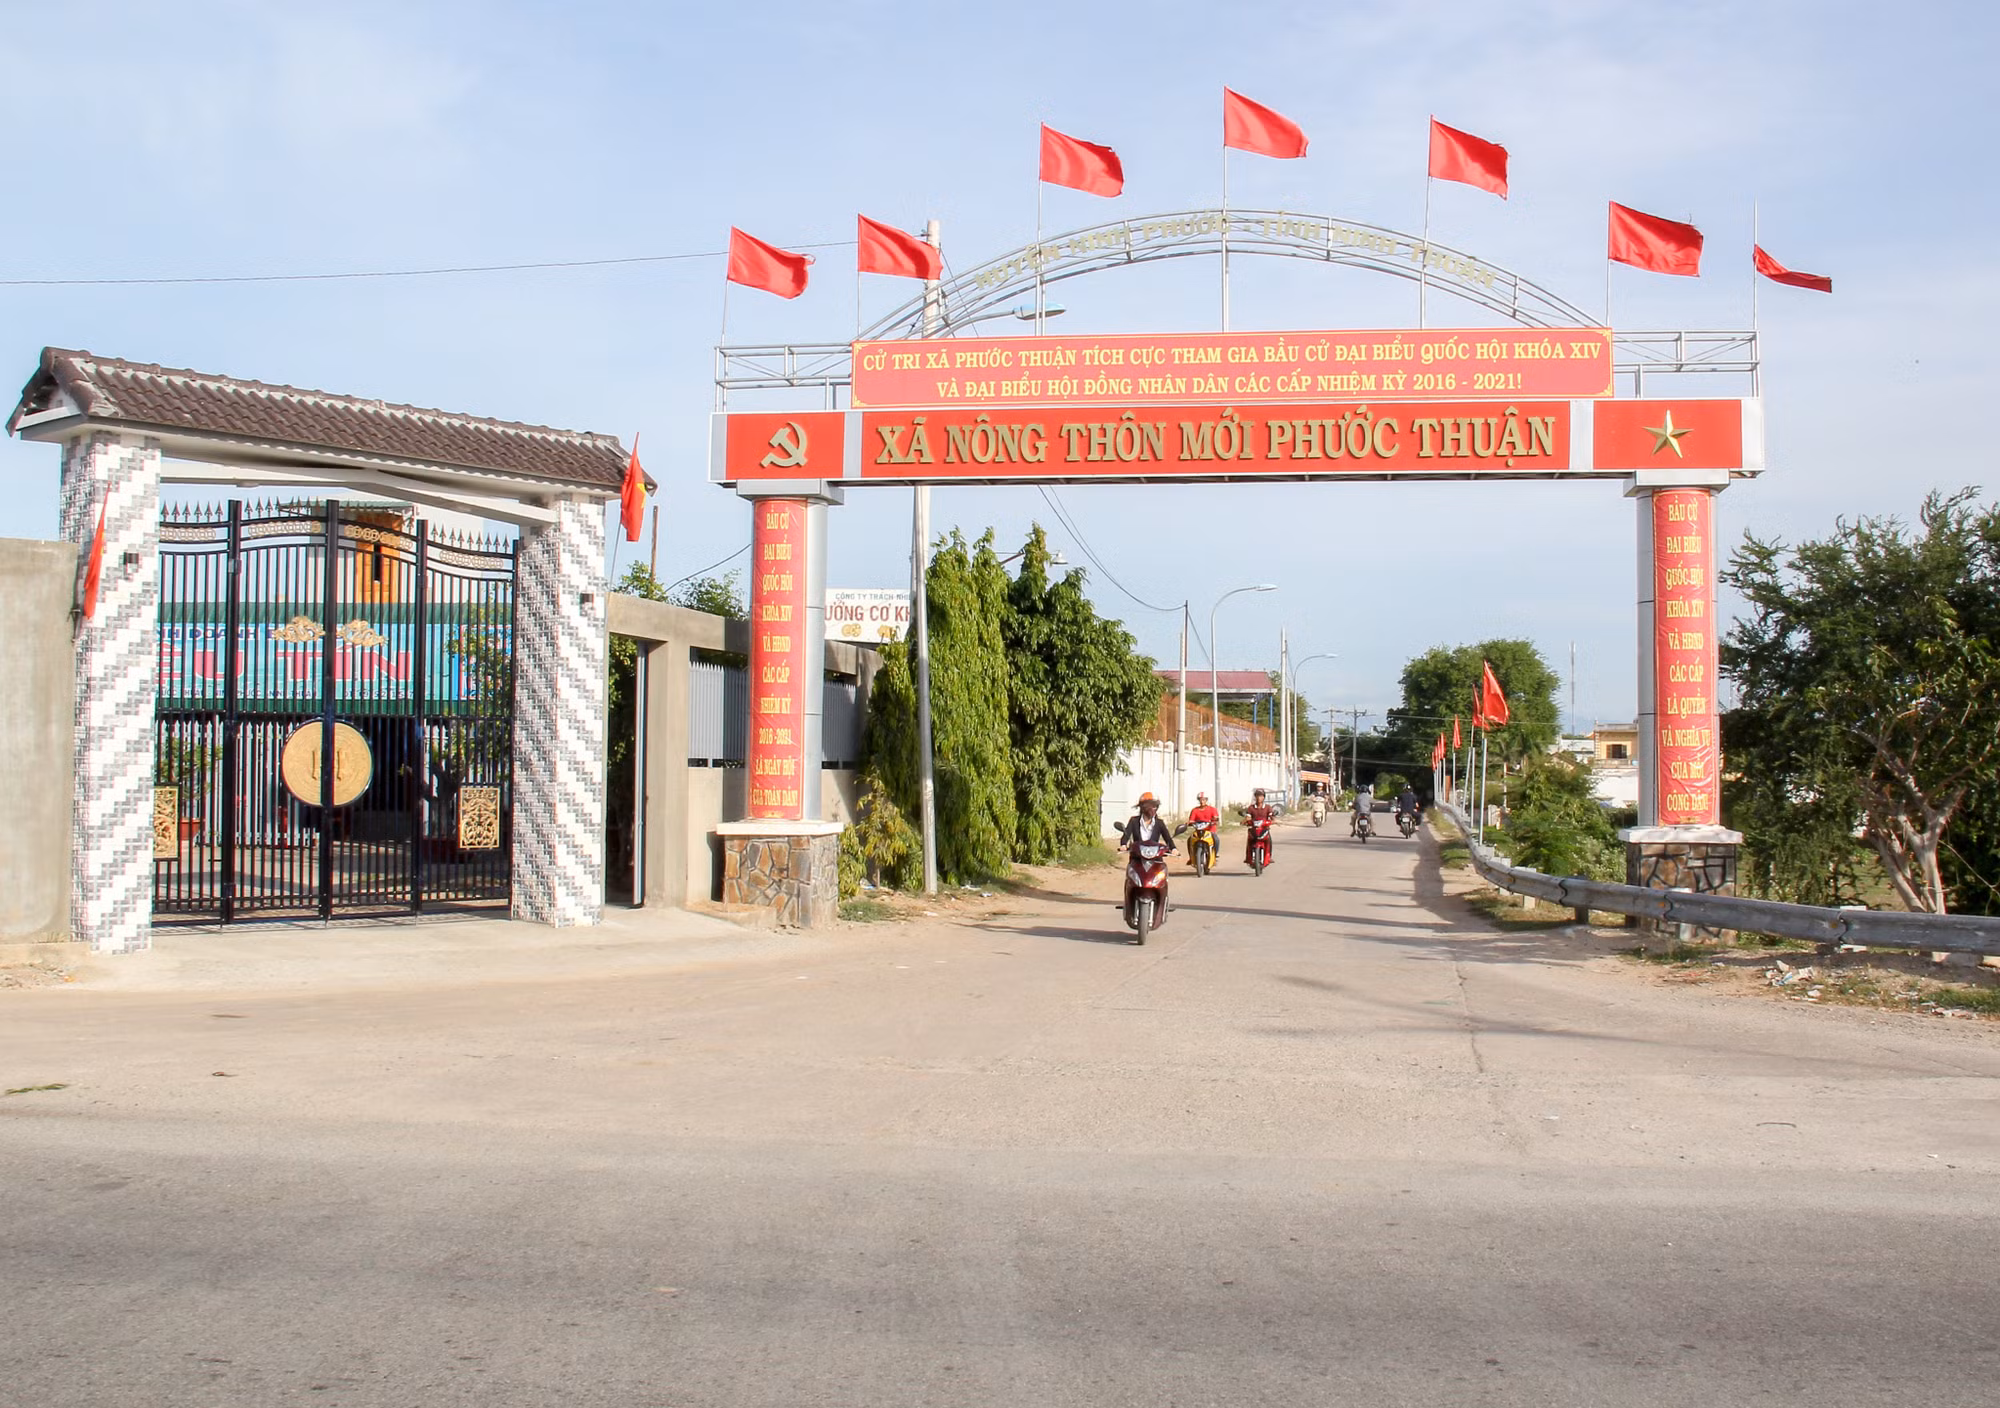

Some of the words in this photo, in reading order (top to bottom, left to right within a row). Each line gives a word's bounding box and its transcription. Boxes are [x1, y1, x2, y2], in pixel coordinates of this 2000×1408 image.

[1069, 227, 1131, 256] NINH
[1333, 226, 1397, 255] NINH
[863, 349, 887, 370] CỬ
[892, 353, 921, 370] TRI
[926, 349, 950, 369] XÃ
[955, 347, 1013, 368] PHƯỚC
[1018, 347, 1076, 368] THUẬN
[1083, 345, 1124, 366] TÍCH
[1130, 348, 1165, 368] CỰC
[1171, 348, 1222, 364] THAM
[1228, 347, 1259, 363] GIA
[1263, 338, 1299, 363] BẦU
[1305, 339, 1329, 362] CỬ
[1335, 344, 1367, 363] ĐẠI
[1372, 335, 1415, 361] BIỂU
[1420, 337, 1470, 364] QUỐC
[1475, 341, 1508, 363] HỘI
[1513, 338, 1566, 360] KHÓA
[1570, 342, 1602, 359] XIV
[937, 376, 960, 398] VÀ
[965, 381, 996, 400] ĐẠI
[1001, 371, 1041, 397] BIỂU
[1047, 376, 1079, 399] HỘI
[1084, 370, 1133, 396] ĐỒNG
[1138, 373, 1187, 395] NHÂN
[1192, 372, 1230, 394] DÂN
[1235, 372, 1271, 393] CÁC
[1277, 368, 1312, 392] CẤP
[1317, 371, 1377, 395] NHIỆM
[1382, 369, 1407, 391] KỲ
[1413, 373, 1456, 390] 2016
[1473, 373, 1522, 390] 2021!
[876, 416, 934, 465] XÃ
[944, 413, 1048, 464] NÔNG
[1060, 410, 1167, 462] THÔN
[1179, 406, 1254, 461] MỚI
[1266, 405, 1401, 460] PHƯỚC
[1411, 406, 1556, 467] THUẬN
[764, 543, 775, 564] ĐẠI
[1666, 536, 1682, 558] ĐẠI
[835, 592, 855, 600] CÔNG
[1666, 596, 1690, 618] KHÓA
[1691, 601, 1705, 617] XIV
[781, 605, 793, 622] XIV
[869, 603, 891, 622] CƠ
[763, 632, 771, 653] VÀ
[1668, 628, 1680, 650] VÀ
[762, 662, 775, 683] CÁC
[776, 659, 790, 683] CẤP
[1670, 660, 1687, 682] CÁC
[1688, 657, 1704, 682] CẤP
[1667, 693, 1679, 714] LÀ
[759, 728, 773, 745] 2016
[1662, 725, 1673, 747] VÀ
[1667, 790, 1690, 811] CÔNG
